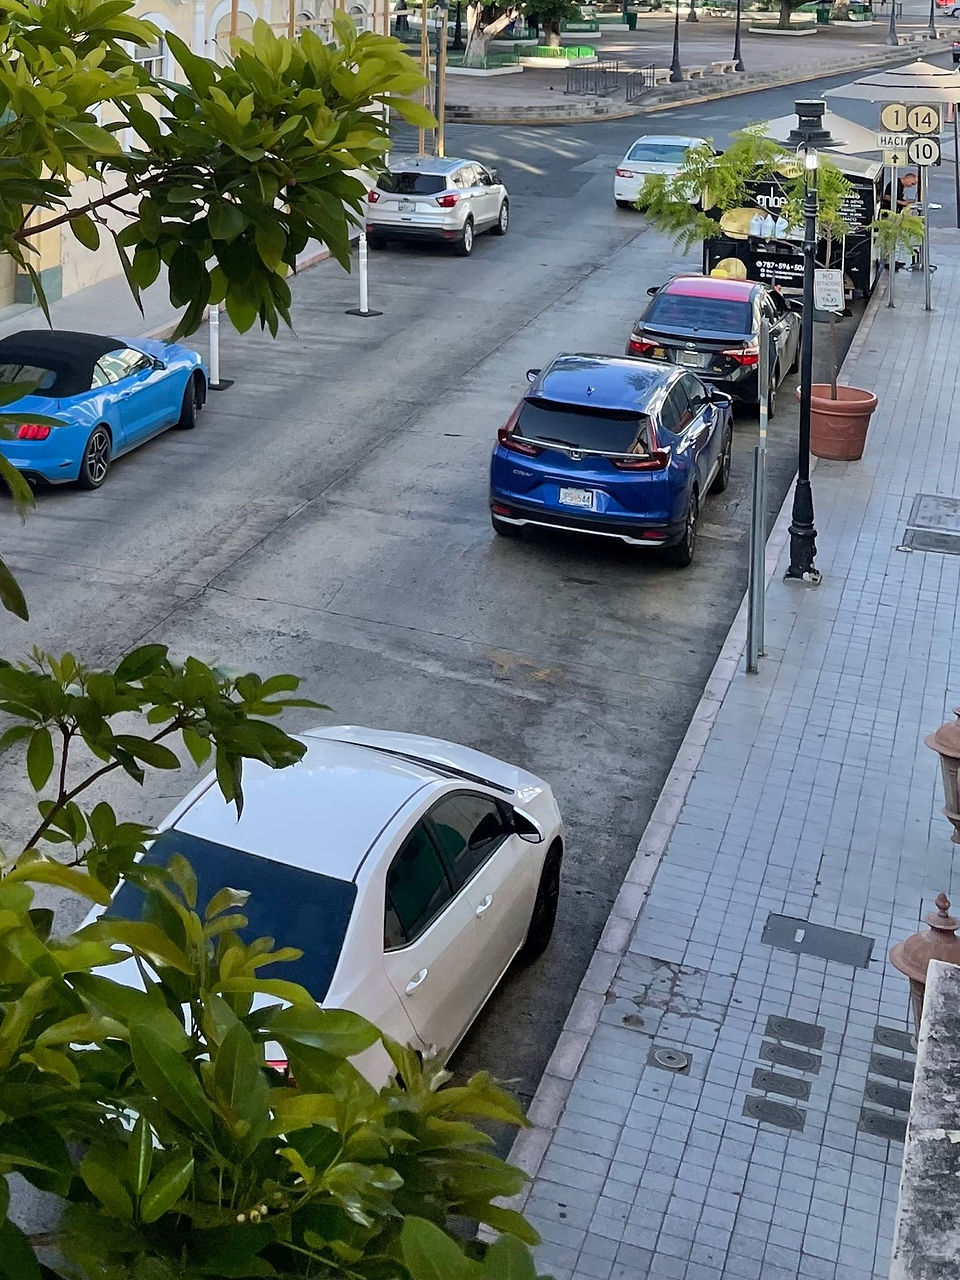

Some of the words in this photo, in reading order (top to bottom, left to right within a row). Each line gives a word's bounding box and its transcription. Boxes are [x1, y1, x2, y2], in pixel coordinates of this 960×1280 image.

[894, 110, 899, 125] 1
[914, 112, 932, 127] 14
[915, 144, 933, 159] 10
[822, 272, 833, 280] NO
